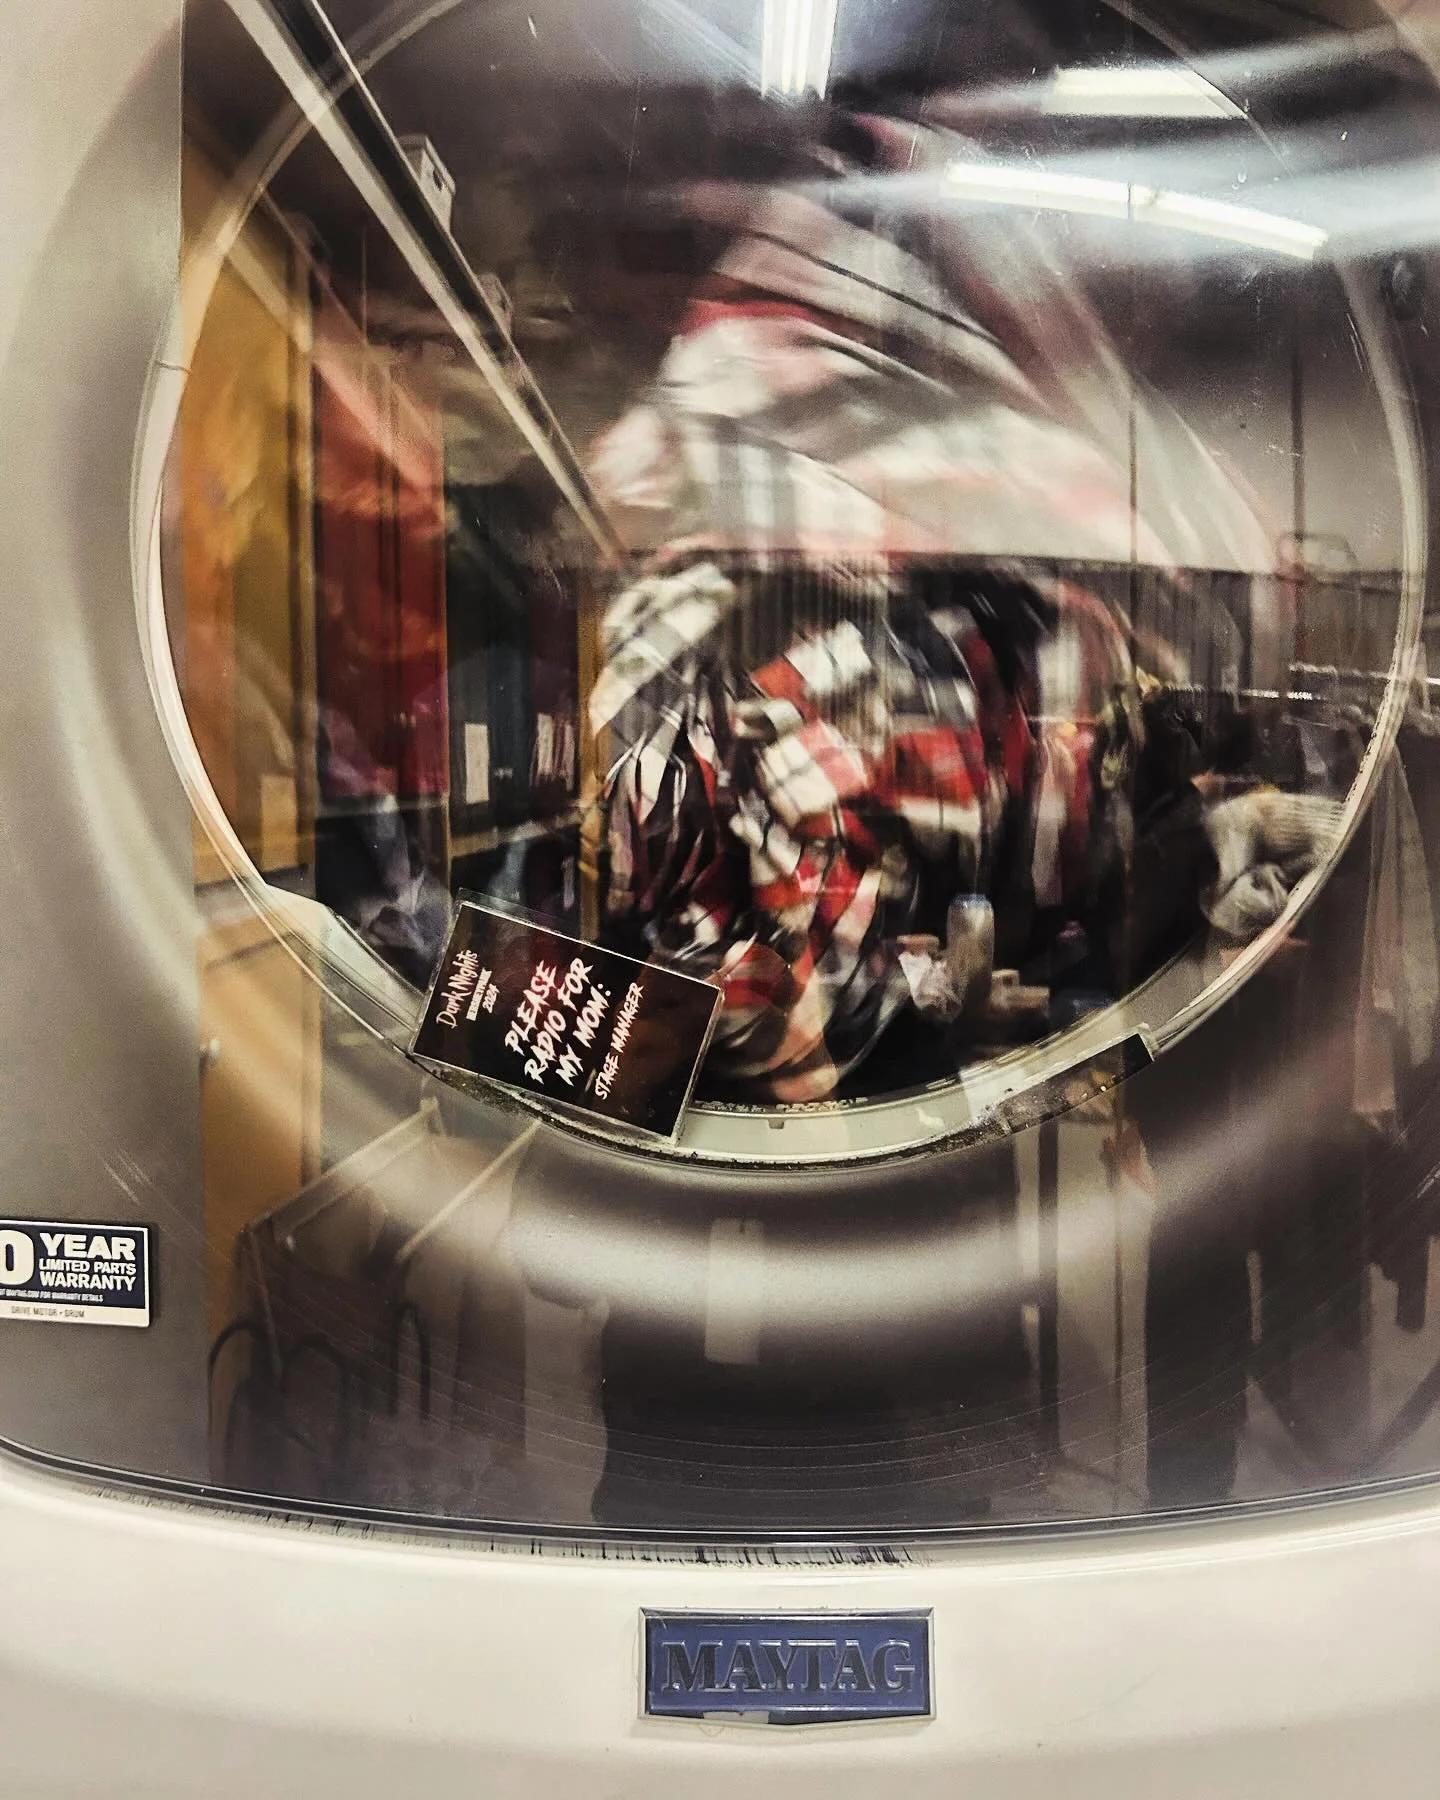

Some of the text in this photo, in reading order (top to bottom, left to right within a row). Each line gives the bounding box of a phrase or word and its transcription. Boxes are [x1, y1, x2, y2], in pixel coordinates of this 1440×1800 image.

[436, 949, 480, 1029] Dark Nights
[482, 983, 500, 1014] 2024
[504, 959, 557, 1057] PLEASE
[524, 957, 594, 1085] RADIO FOR
[555, 983, 612, 1087] MY MOM:
[595, 982, 645, 1100] STAGE MANAGER
[39, 1232, 136, 1260] YEAR
[39, 1258, 137, 1275] LIMITED PARTS
[39, 1271, 136, 1291] WARRANTY
[660, 1639, 917, 1694] MAYTAG
